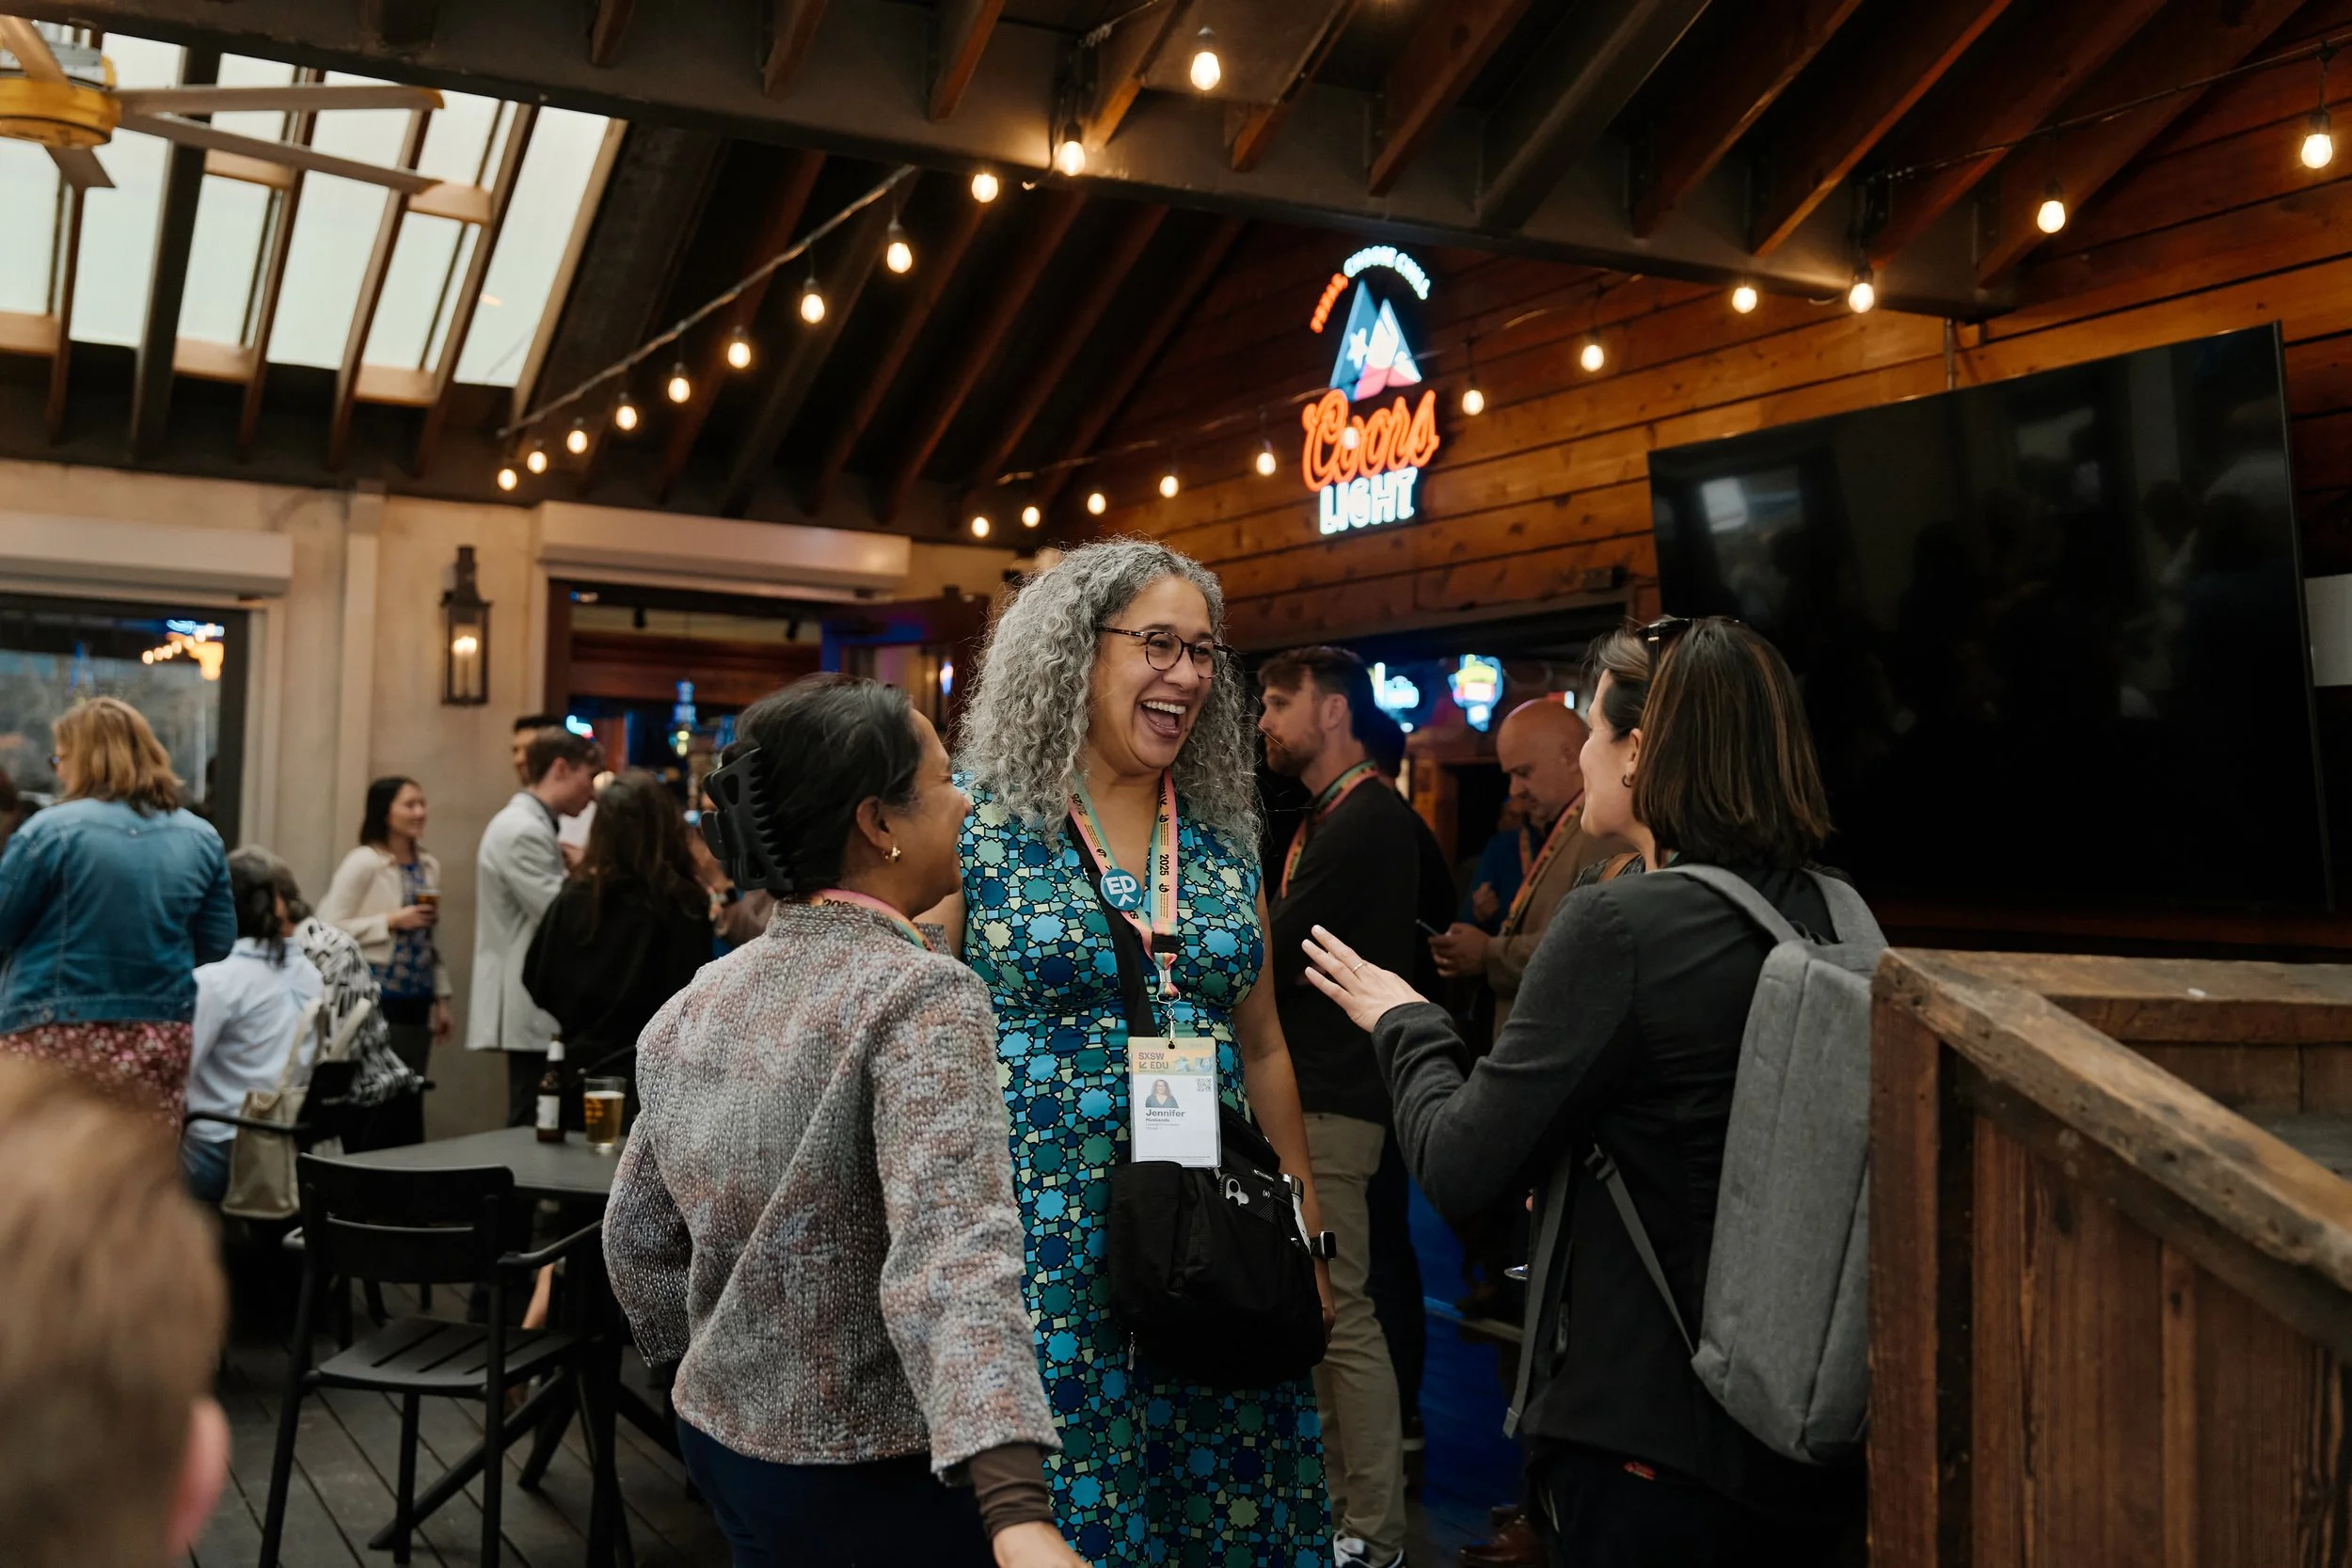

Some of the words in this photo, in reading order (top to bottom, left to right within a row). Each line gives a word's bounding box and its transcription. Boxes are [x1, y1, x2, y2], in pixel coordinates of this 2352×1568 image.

[1302, 388, 1440, 492] Coors
[1319, 467, 1419, 534] LIGHT
[1159, 854, 1169, 876] 2025
[1138, 1052, 1165, 1060] SXSW
[1150, 1061, 1169, 1069] EDU
[1146, 1108, 1185, 1117] Jennifer
